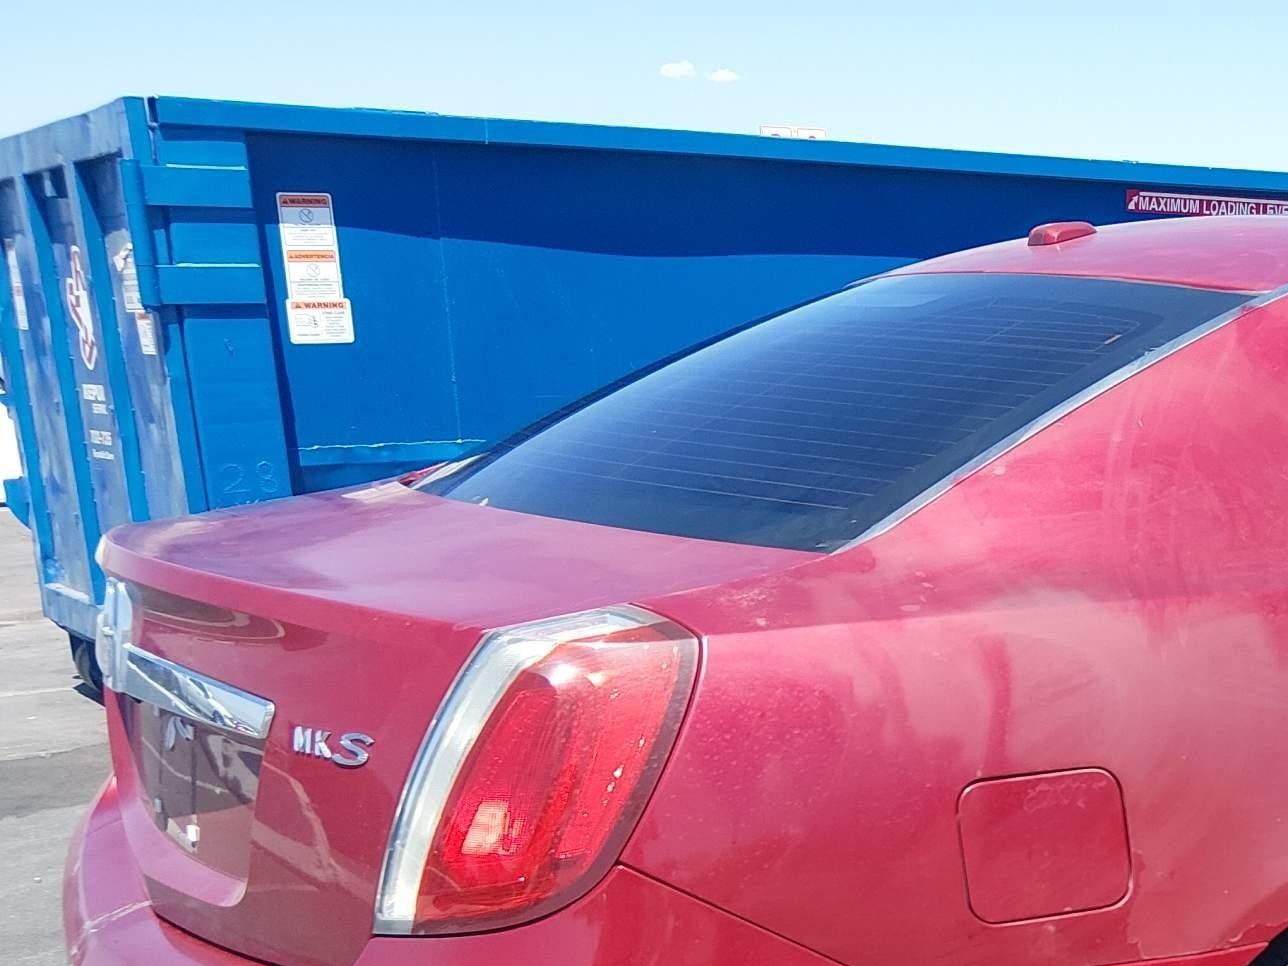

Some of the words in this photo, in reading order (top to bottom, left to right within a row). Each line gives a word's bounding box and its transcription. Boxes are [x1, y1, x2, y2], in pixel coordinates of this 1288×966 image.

[1139, 196, 1200, 214] MAXIMUM
[1203, 200, 1257, 216] LOADING
[293, 725, 375, 768] MKS
